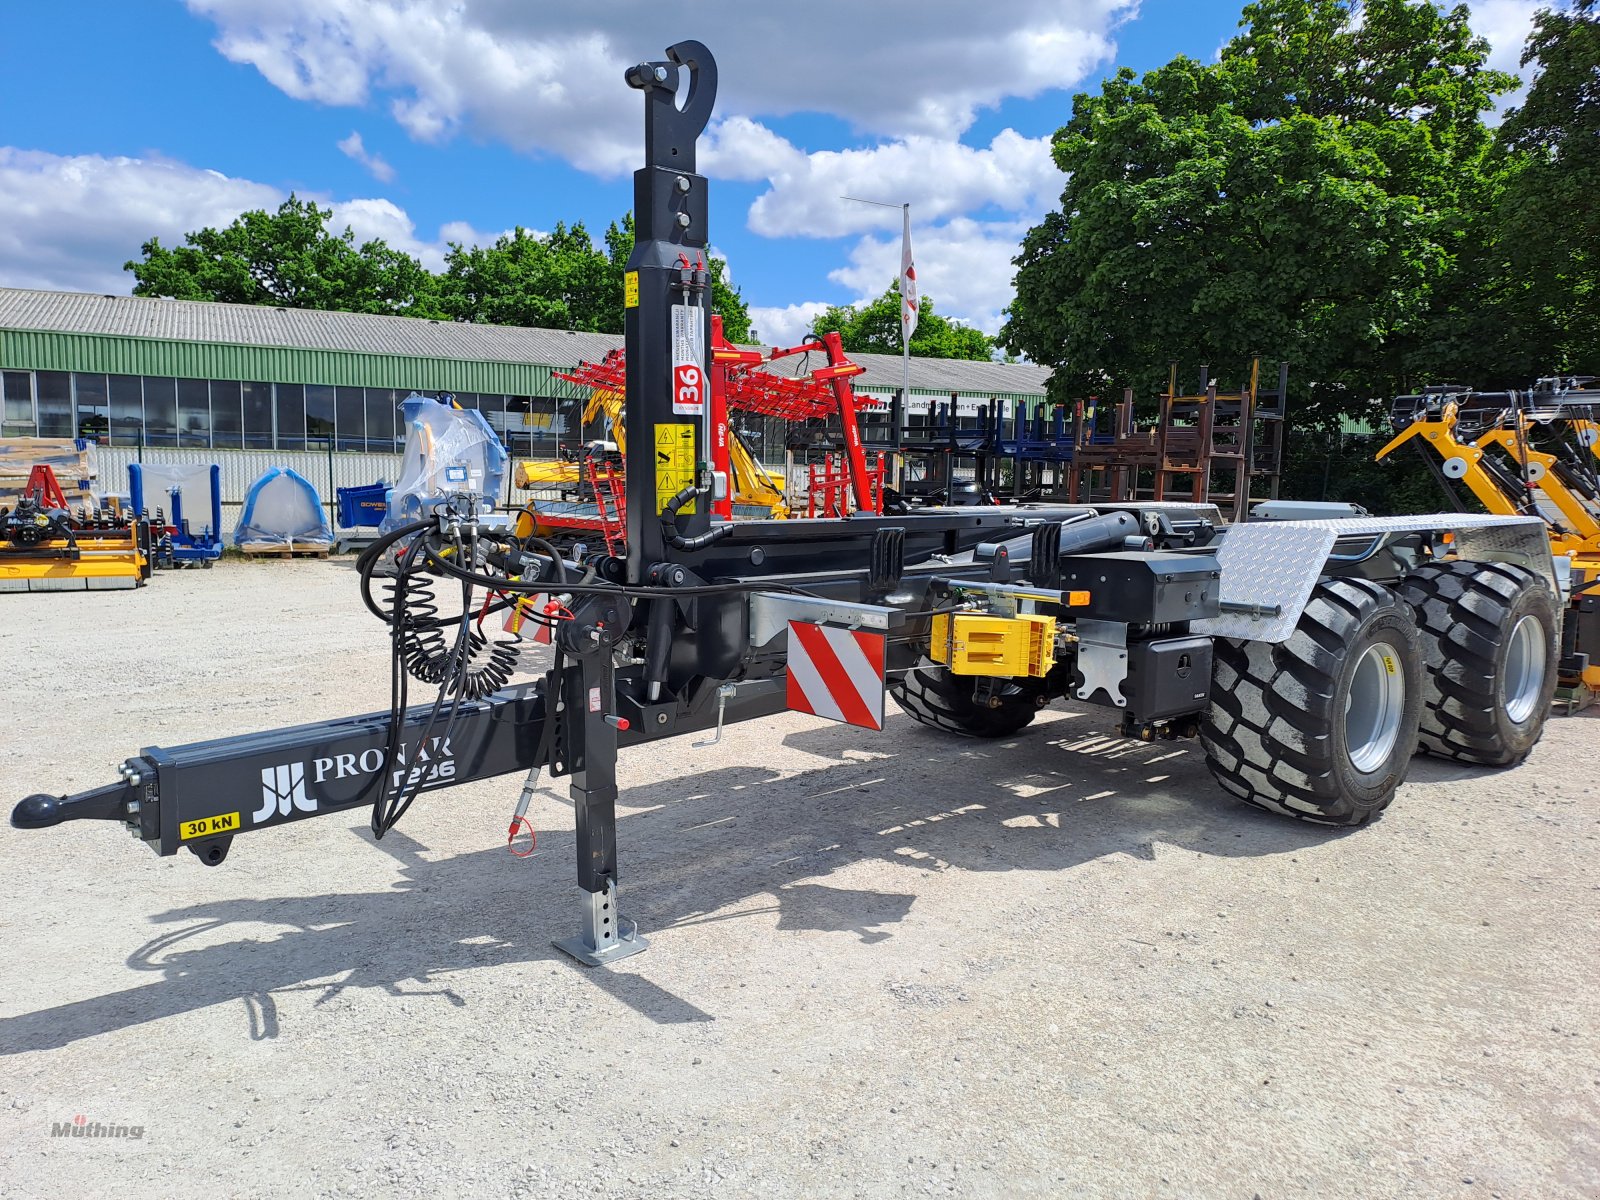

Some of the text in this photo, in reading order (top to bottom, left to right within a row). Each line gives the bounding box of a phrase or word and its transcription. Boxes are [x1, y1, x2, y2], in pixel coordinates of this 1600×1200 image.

[679, 369, 699, 402] 36
[851, 424, 859, 447] Weeder
[188, 815, 233, 836] 30 kN
